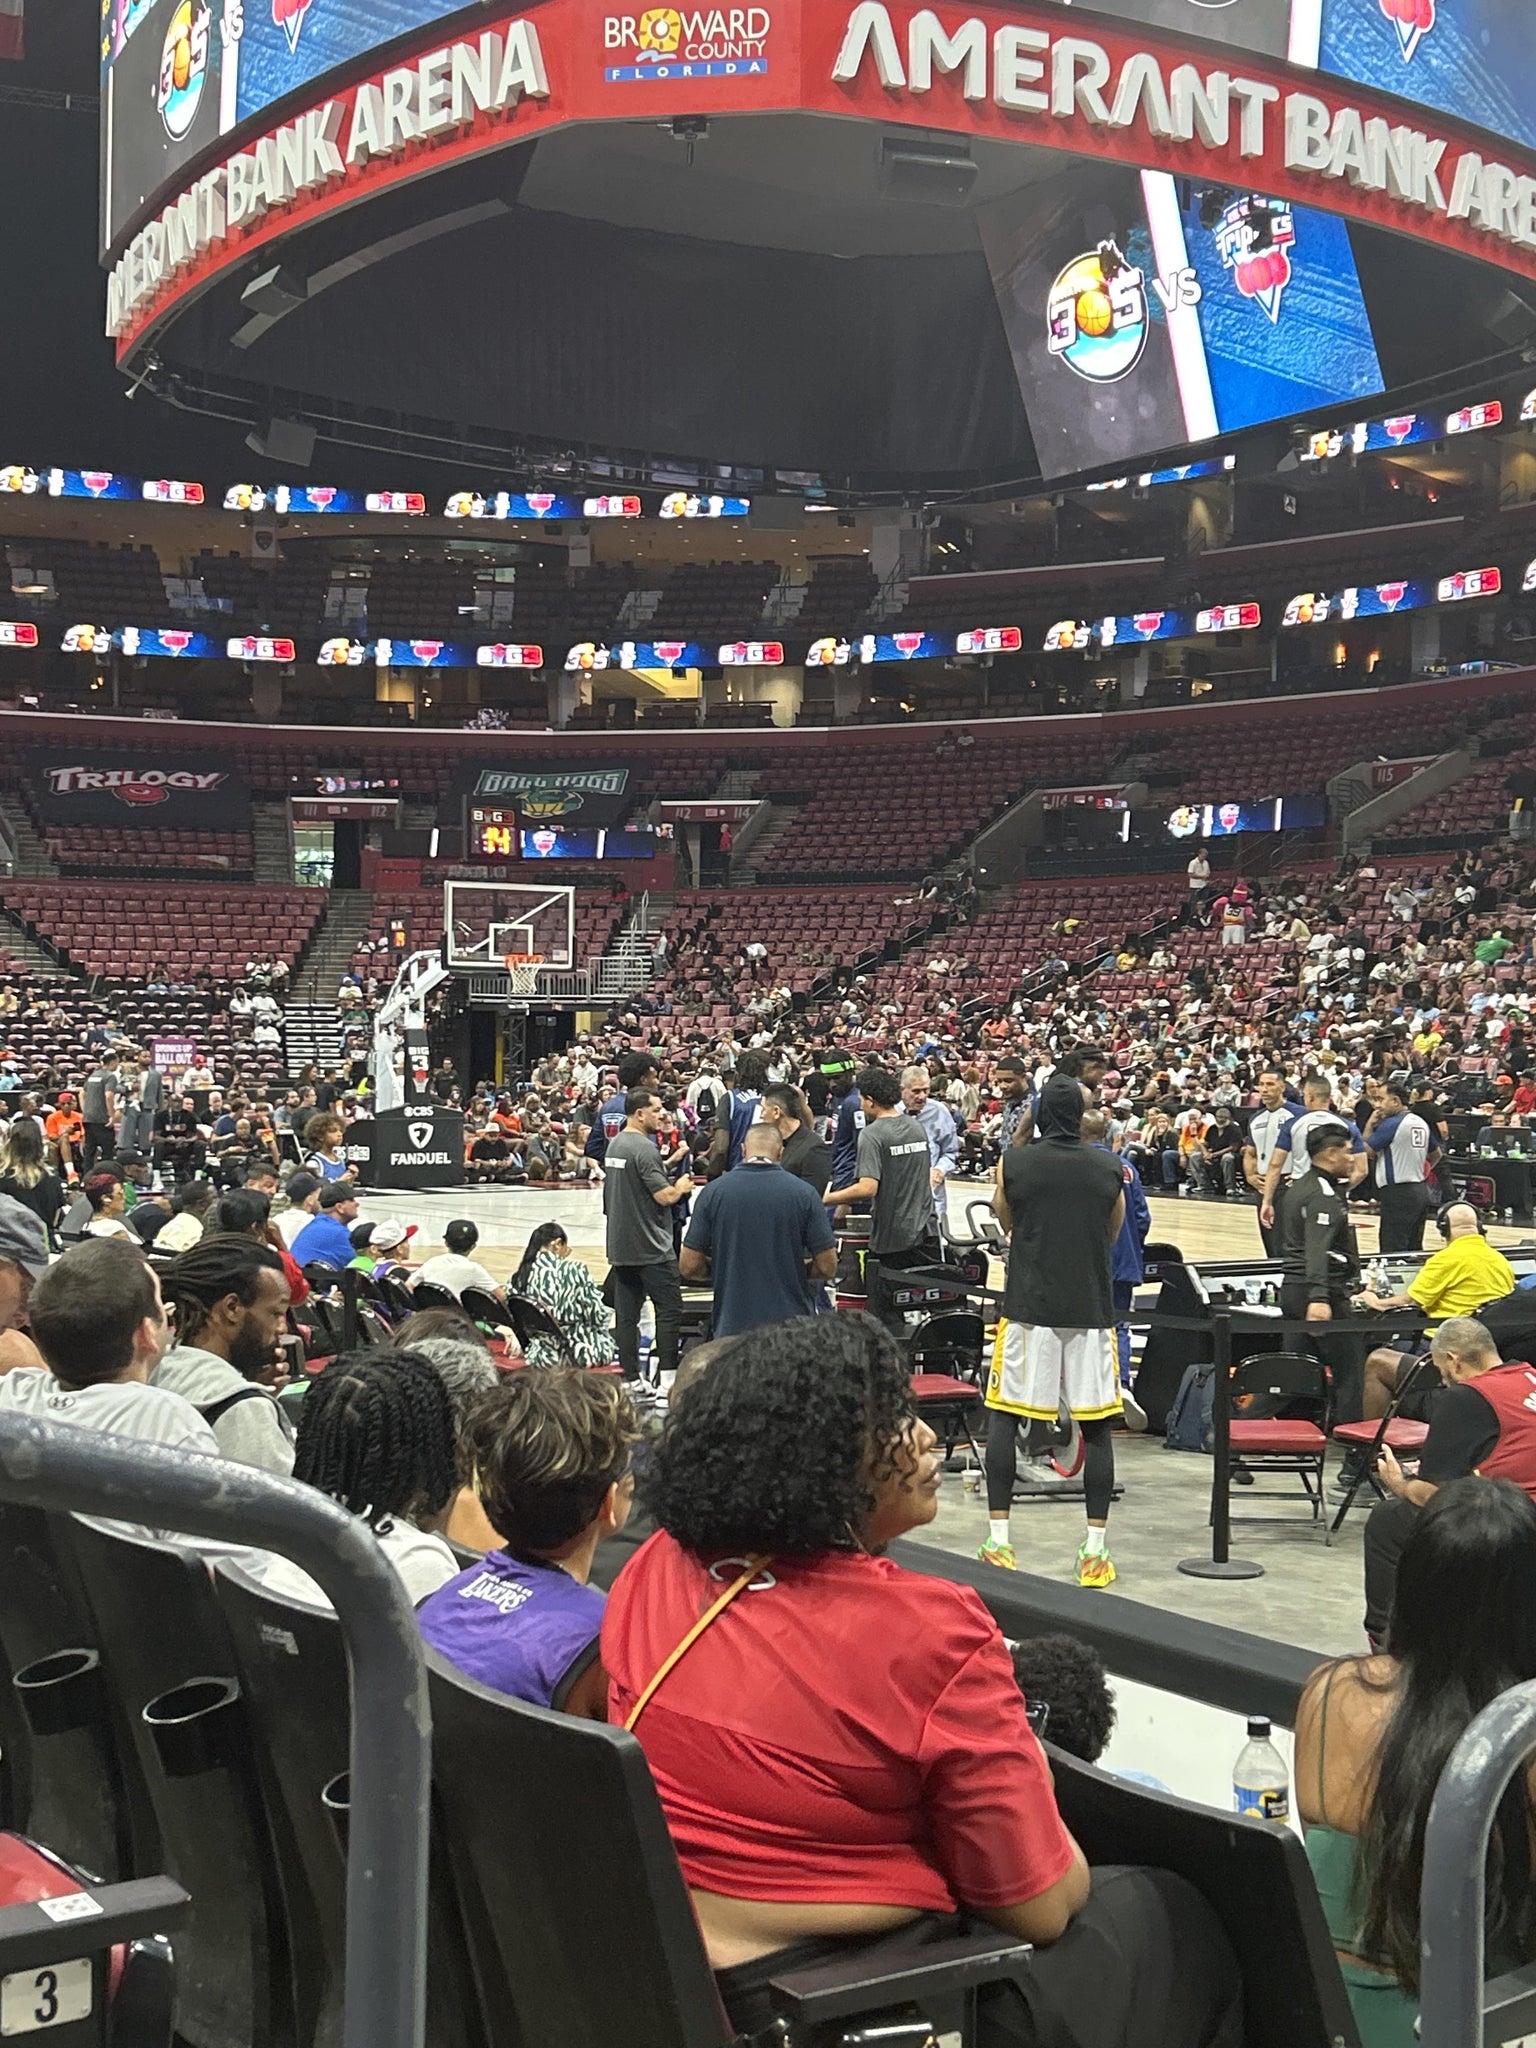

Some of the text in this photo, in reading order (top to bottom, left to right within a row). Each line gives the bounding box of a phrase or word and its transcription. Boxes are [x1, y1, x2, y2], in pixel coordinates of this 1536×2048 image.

[605, 8, 770, 49] BROWARD
[685, 40, 766, 60] COUNTY
[612, 62, 761, 80] FLORIDA
[831, 0, 1278, 157] AMERANT
[1286, 92, 1447, 212] BANK
[227, 101, 346, 230] BANK
[346, 18, 550, 166] ARENA
[1152, 268, 1203, 313] VS
[50, 767, 221, 791] TRILOGY
[155, 1053, 175, 1065] BALL
[408, 1047, 430, 1056] BIG
[411, 1056, 429, 1070] 3
[412, 1106, 434, 1117] CBS
[391, 1152, 451, 1166] FANDUEL
[34, 1971, 58, 2023] 3
